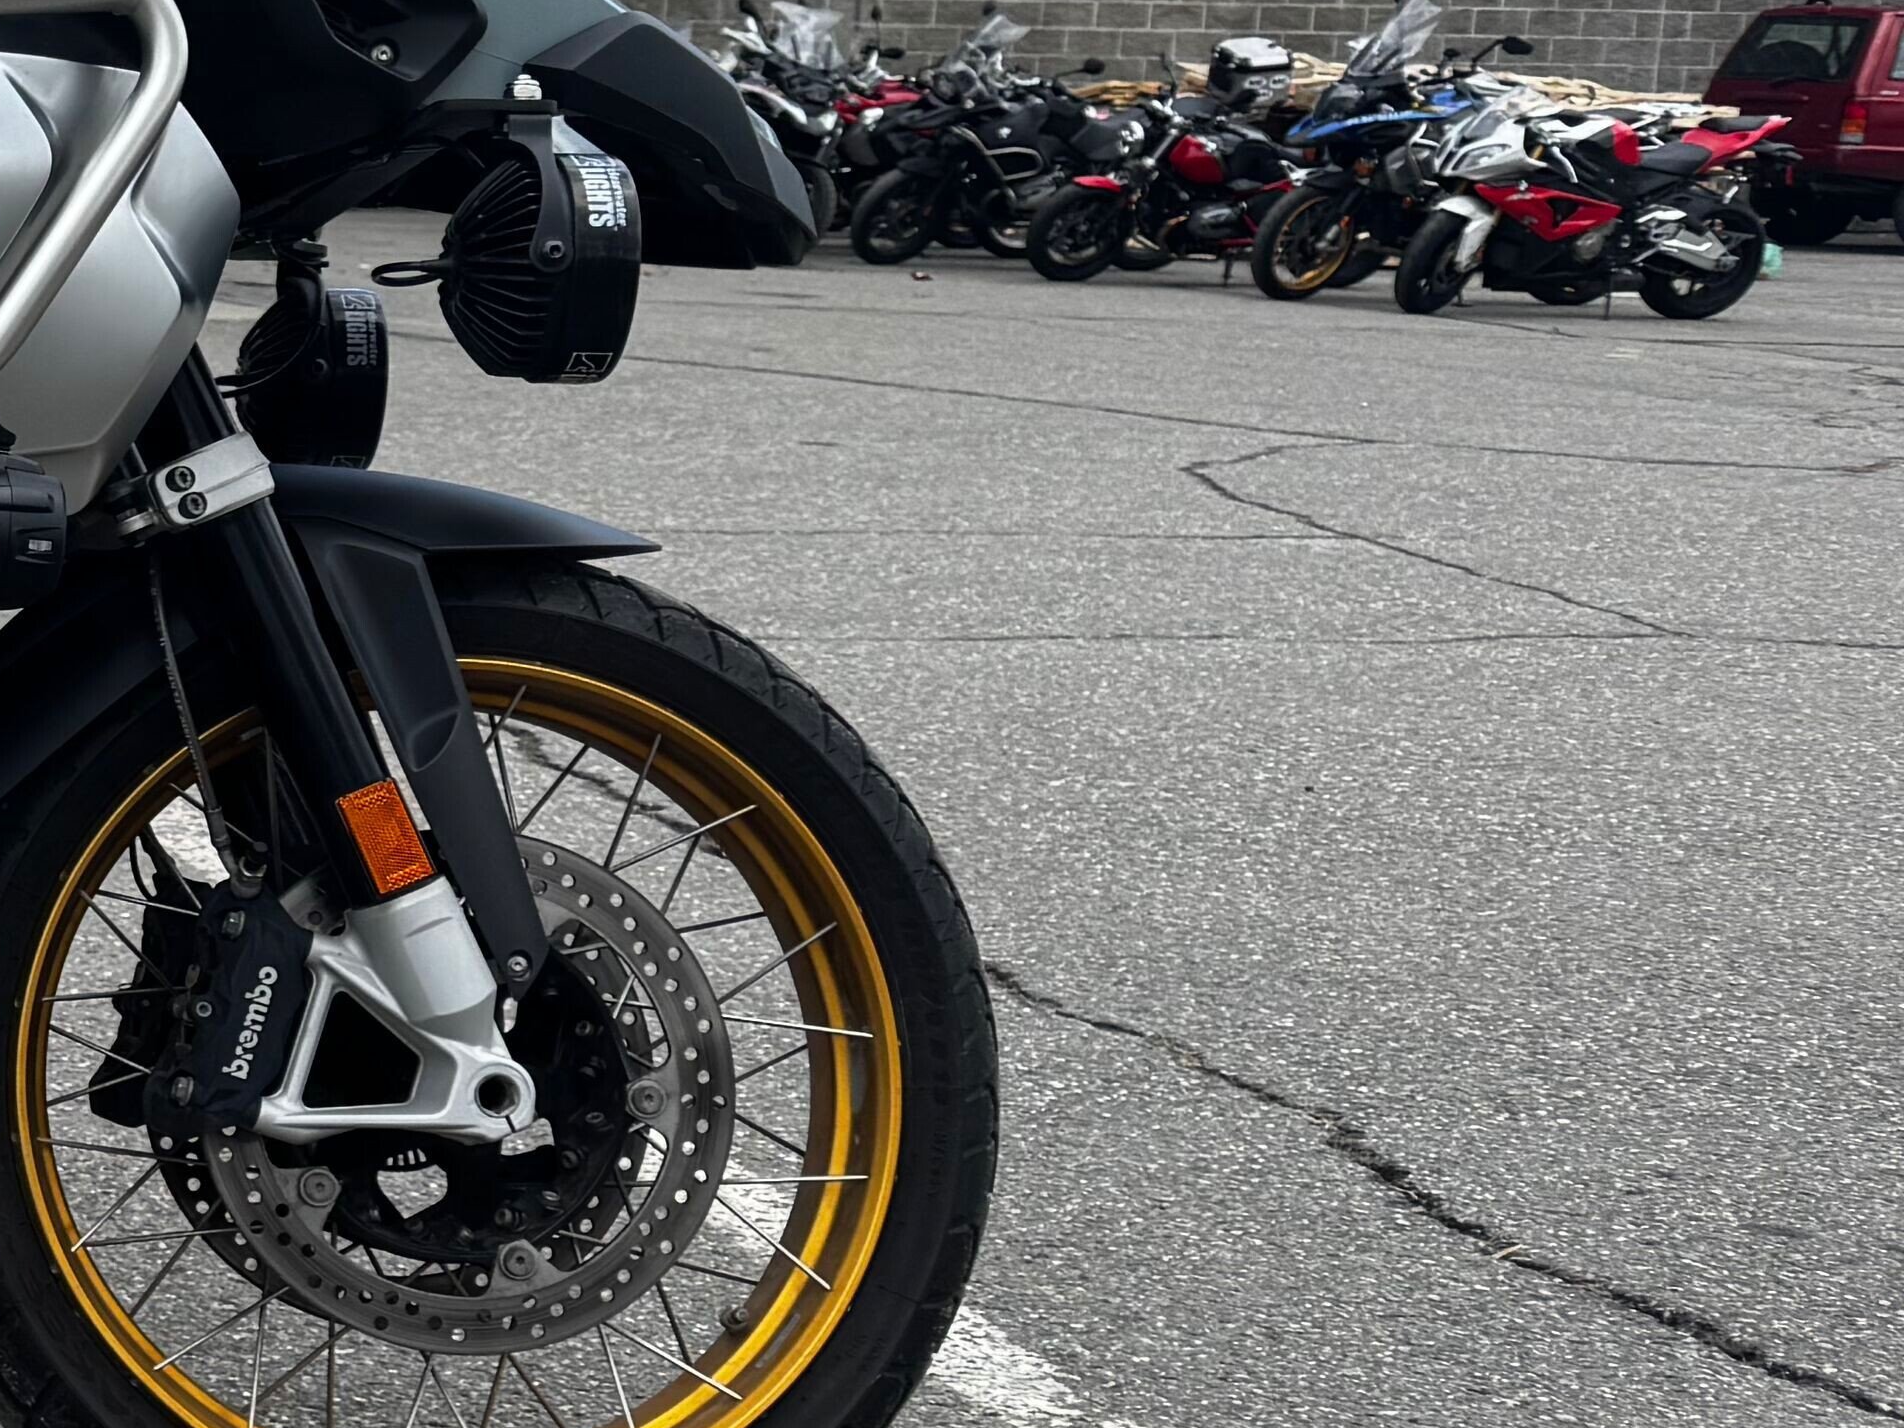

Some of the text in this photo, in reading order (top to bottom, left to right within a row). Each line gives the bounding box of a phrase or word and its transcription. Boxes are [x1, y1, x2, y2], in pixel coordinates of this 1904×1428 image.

[578, 168, 616, 227] LIGHTS
[344, 311, 368, 366] LIGHTS
[222, 965, 278, 1080] brembo
